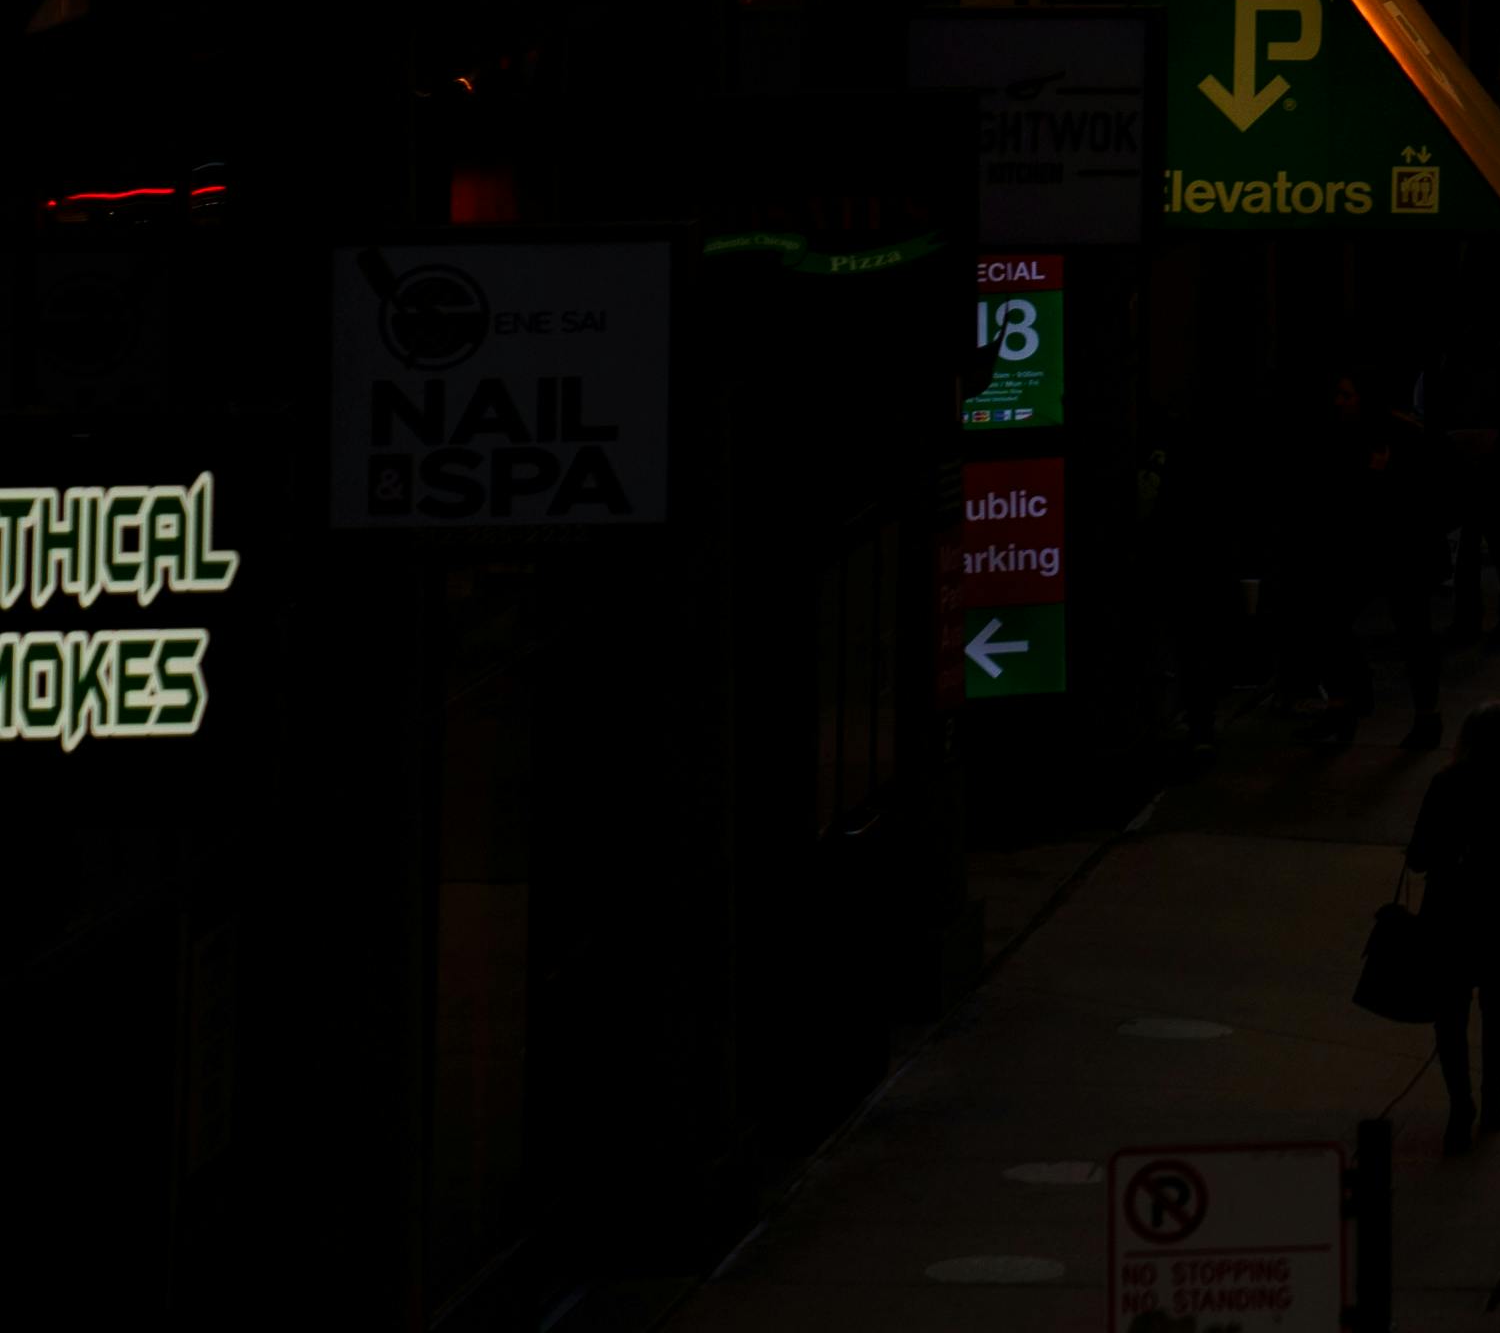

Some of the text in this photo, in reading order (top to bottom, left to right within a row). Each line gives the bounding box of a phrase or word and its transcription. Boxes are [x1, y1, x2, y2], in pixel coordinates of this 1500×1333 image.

[832, 249, 904, 272] Pizza
[369, 377, 619, 445] NAIL
[415, 446, 634, 518] SPA
[964, 489, 1048, 523] ublic
[1121, 1258, 1291, 1287] NO STOPPING
[1121, 1287, 1292, 1314] NO STANDING
